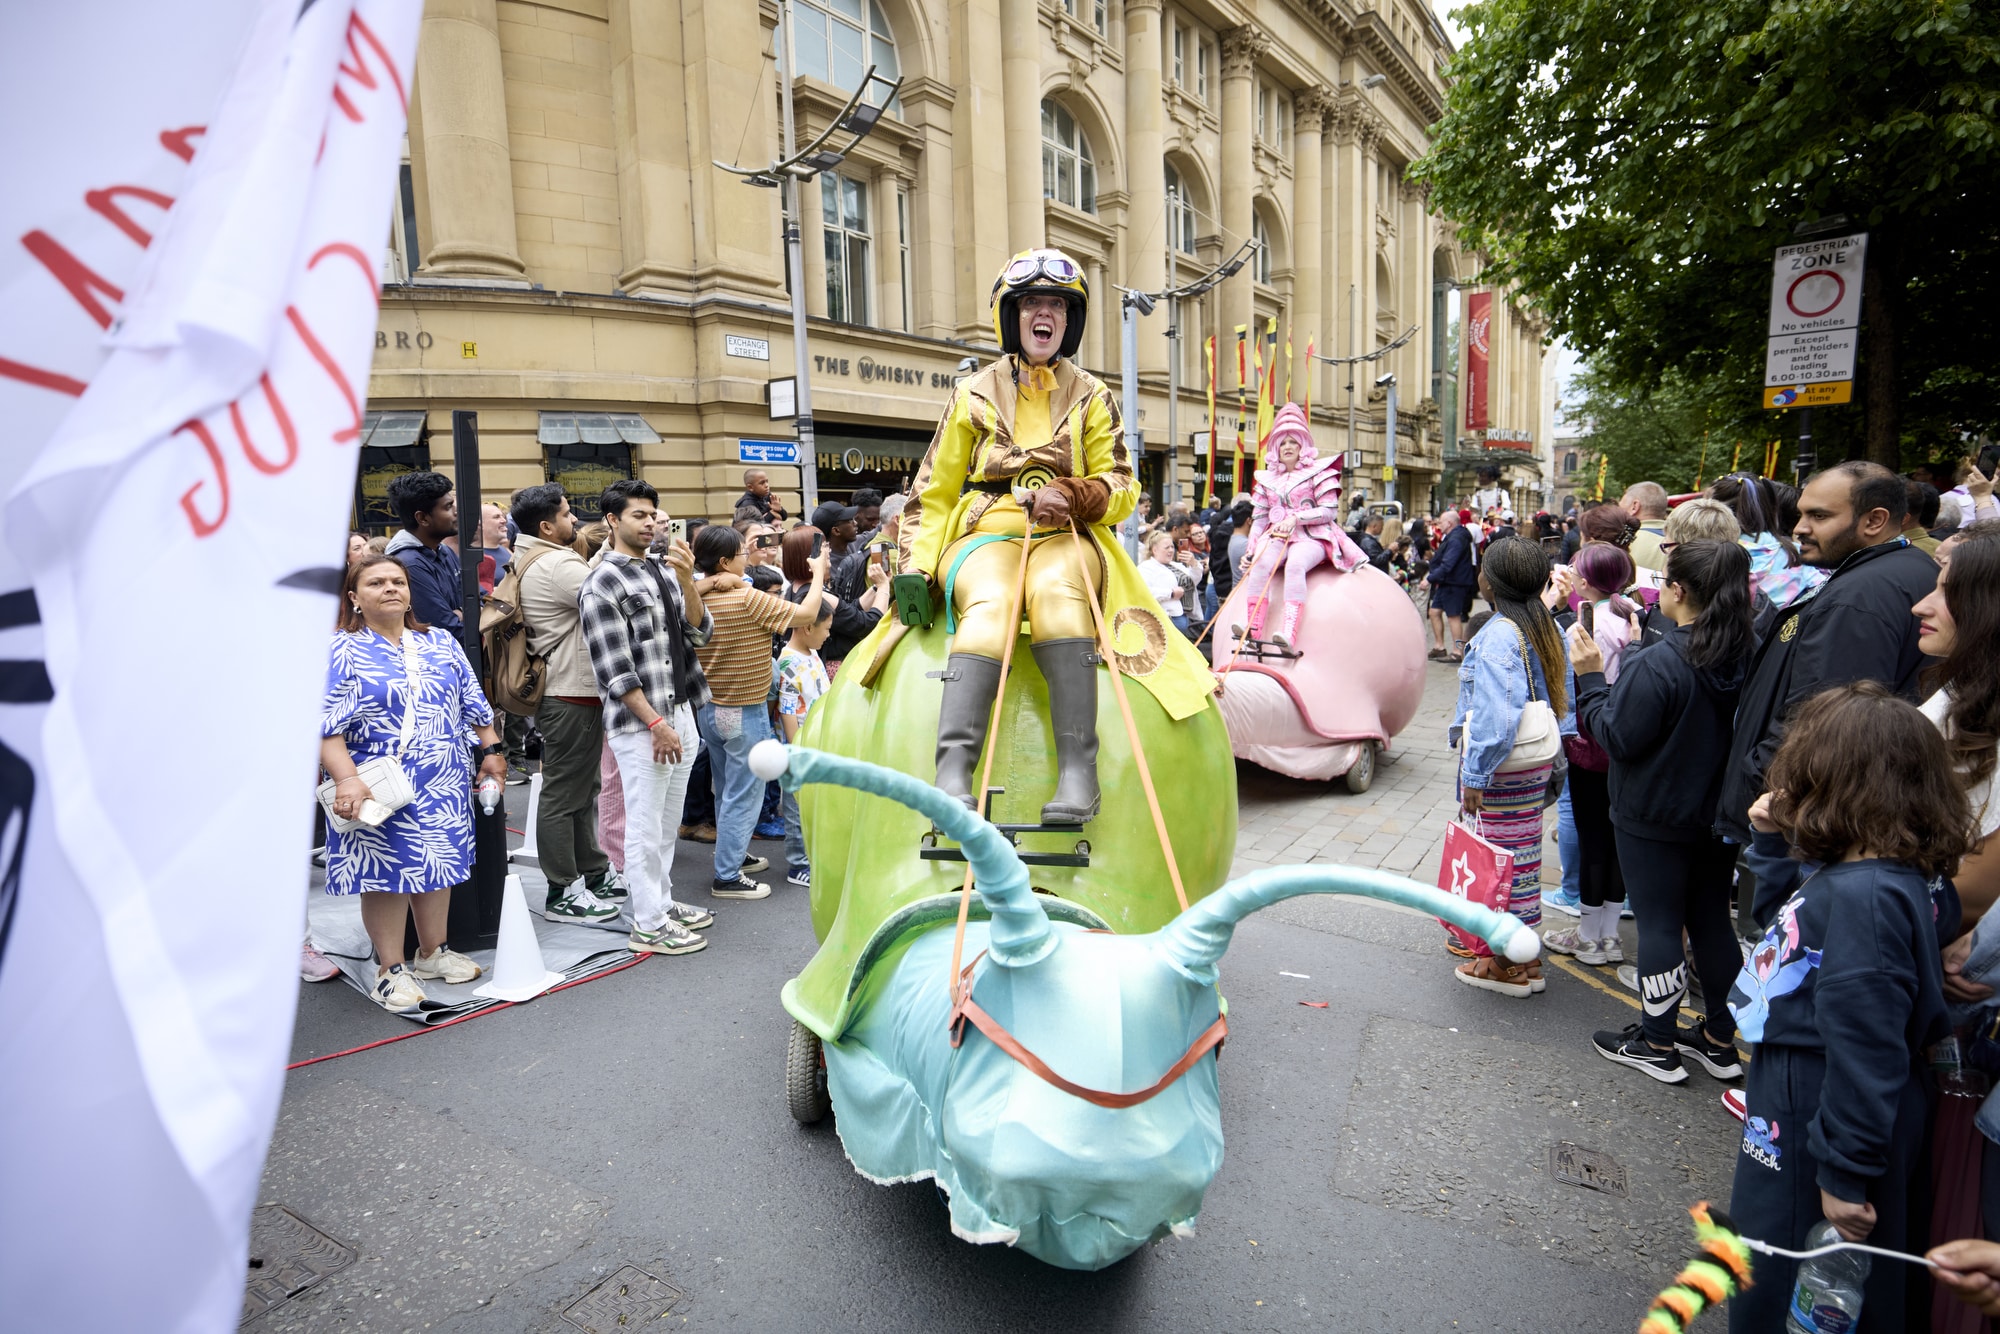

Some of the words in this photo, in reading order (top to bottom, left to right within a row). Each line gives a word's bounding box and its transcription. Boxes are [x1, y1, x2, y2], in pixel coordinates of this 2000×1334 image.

[1781, 238, 1859, 256] PEDESTRIAN
[1791, 251, 1846, 270] ZONE
[1781, 323, 1797, 331] No
[1801, 318, 1845, 329] vehicles
[728, 337, 766, 350] EXCHANGE
[1794, 335, 1829, 345] Except
[463, 342, 476, 357] H
[734, 347, 761, 358] STREET
[1773, 346, 1806, 356] permit
[1810, 342, 1849, 352] holders
[1791, 353, 1810, 362] and
[814, 355, 850, 376] THE
[858, 358, 924, 386] WHISKY
[931, 372, 957, 389] SHO
[1790, 362, 1828, 371] loading
[1819, 386, 1837, 394] any
[1203, 413, 1225, 427] MNT
[1228, 417, 1256, 431] VEET
[1487, 429, 1514, 441] ROYAL
[817, 452, 842, 469] HE
[845, 452, 913, 473] WHISKY
[1214, 473, 1233, 483] VELVE
[1641, 960, 1688, 999] NIKE
[1742, 1137, 1781, 1171] Stitch
